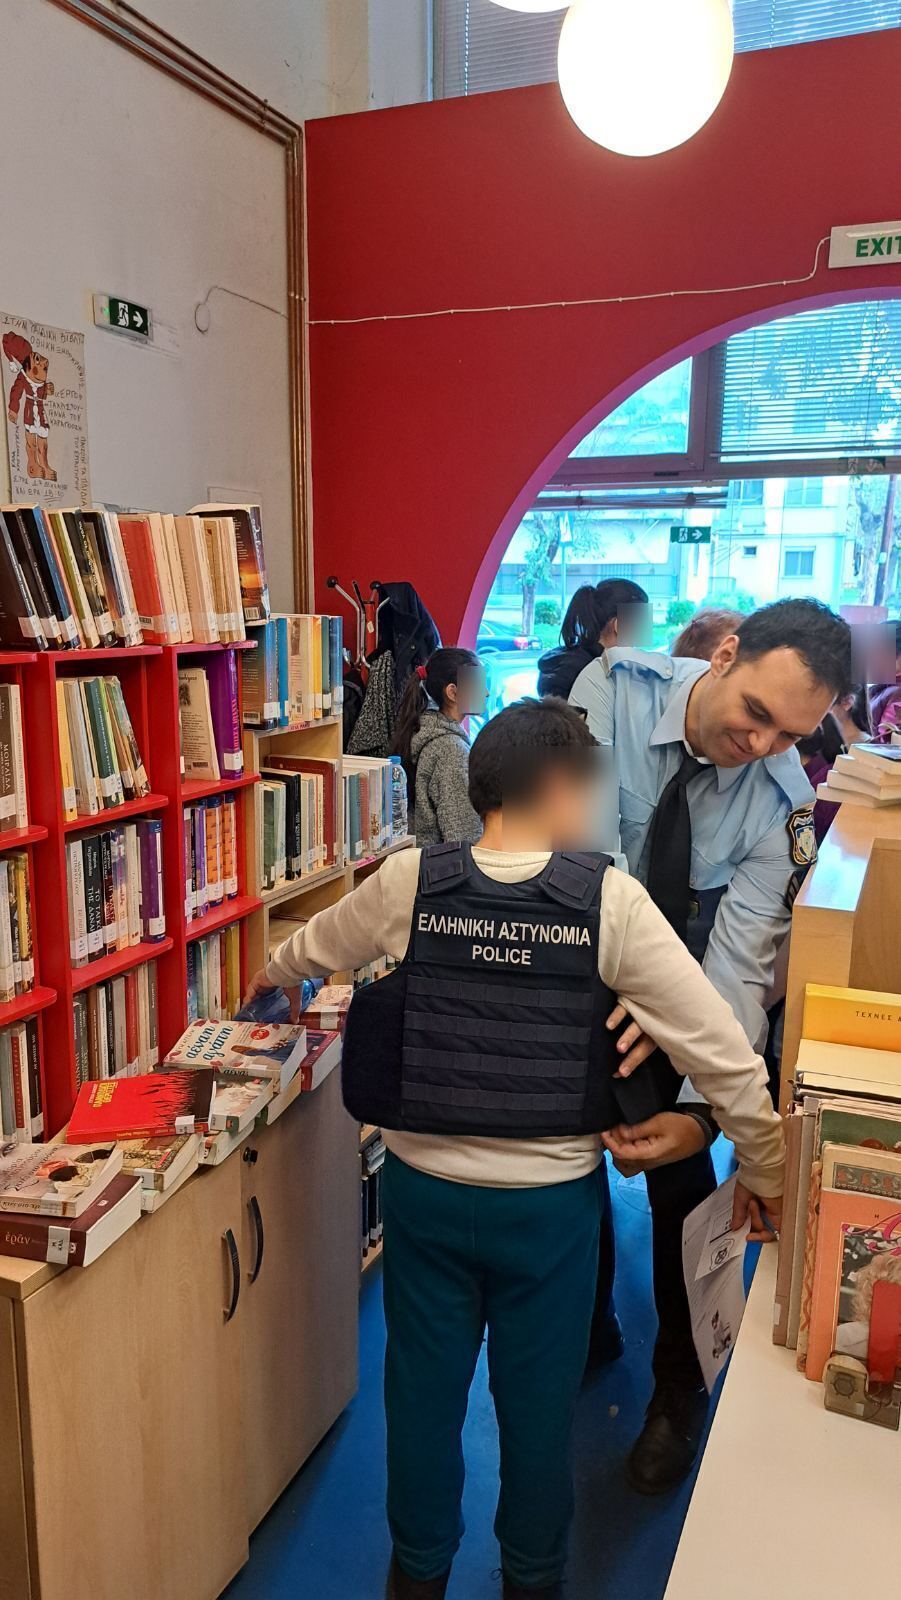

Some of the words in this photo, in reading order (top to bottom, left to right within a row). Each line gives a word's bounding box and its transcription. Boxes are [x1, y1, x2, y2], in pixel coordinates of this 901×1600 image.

[856, 235, 901, 258] EXIT
[417, 913, 495, 939] ΕΛΛΗΝΙΚΗ
[498, 921, 591, 946] ΑΣΤΥΝΟΜΙΑ
[472, 945, 532, 965] POLICE
[202, 1025, 234, 1061] αγάπη
